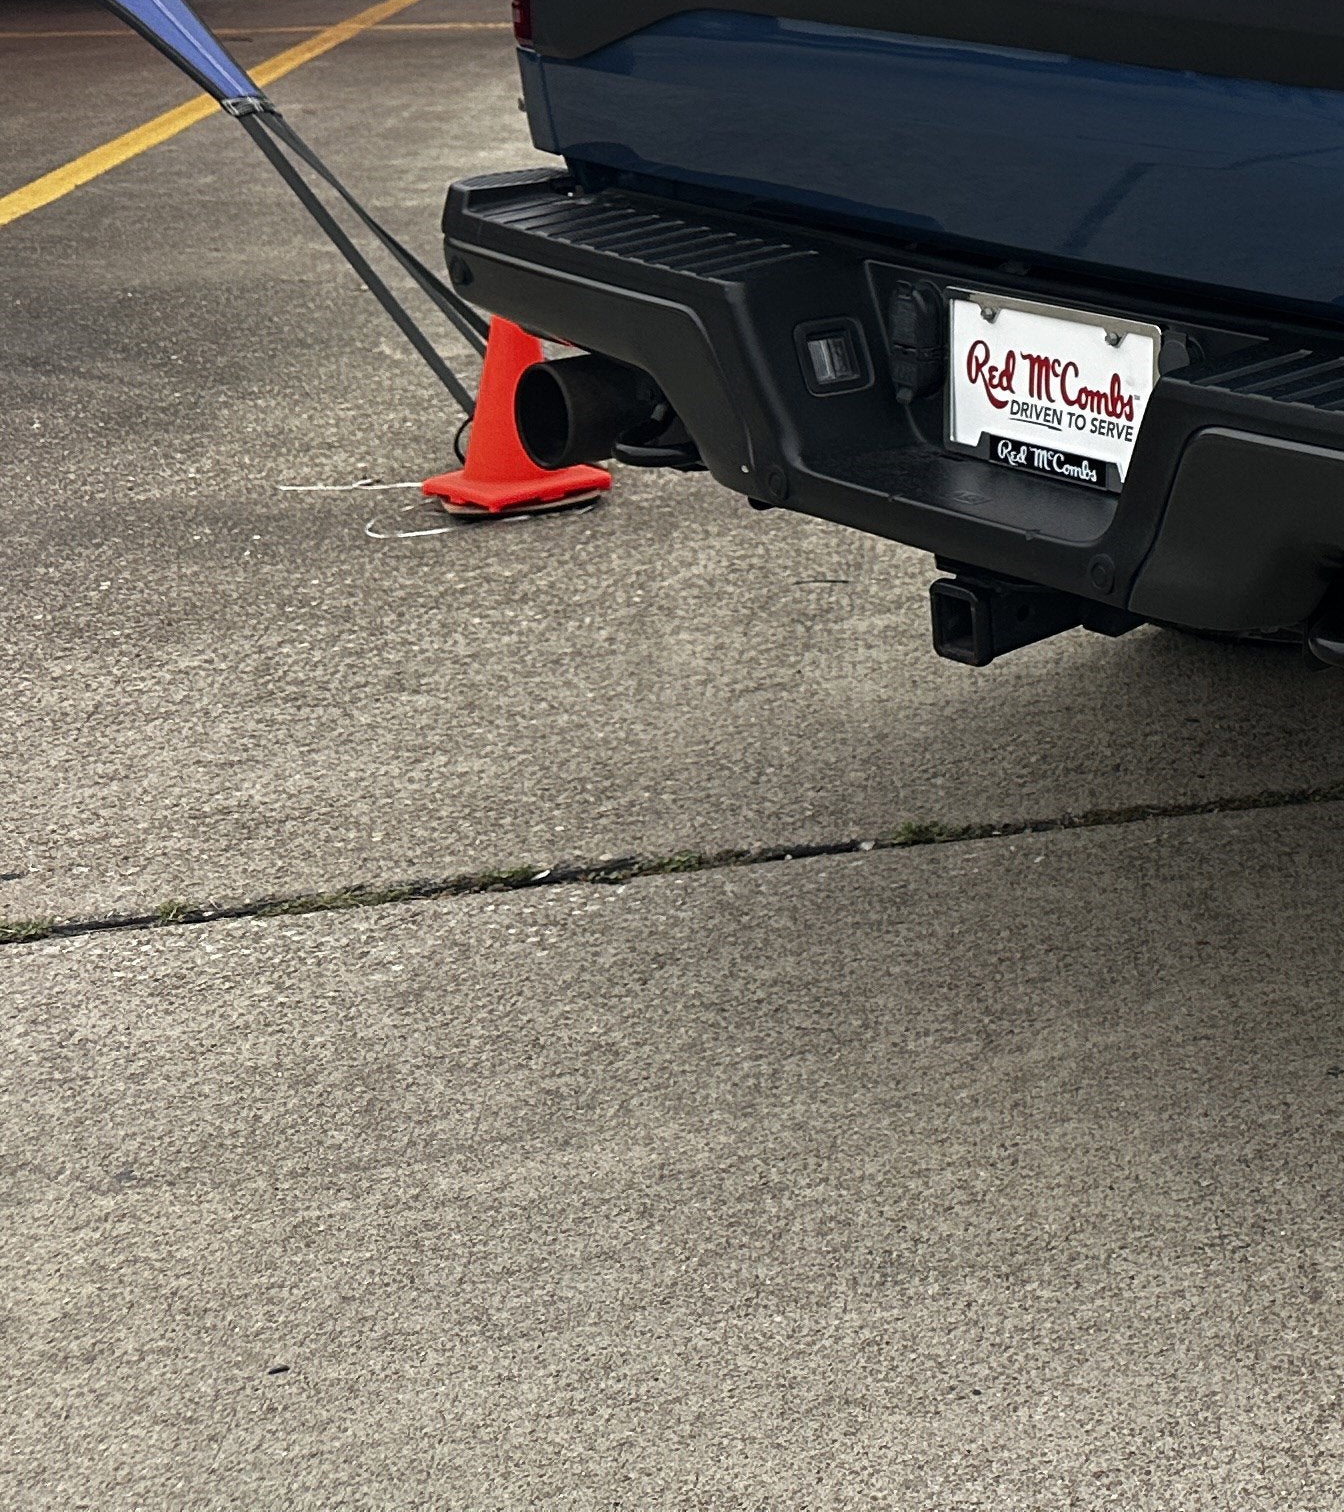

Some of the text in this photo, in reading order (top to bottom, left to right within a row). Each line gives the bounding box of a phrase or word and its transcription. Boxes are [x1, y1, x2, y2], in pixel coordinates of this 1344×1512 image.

[966, 340, 1135, 422] Red McCombs
[1009, 399, 1135, 443] DRIVEN TO SERVE
[997, 439, 1097, 482] Red McCombs
